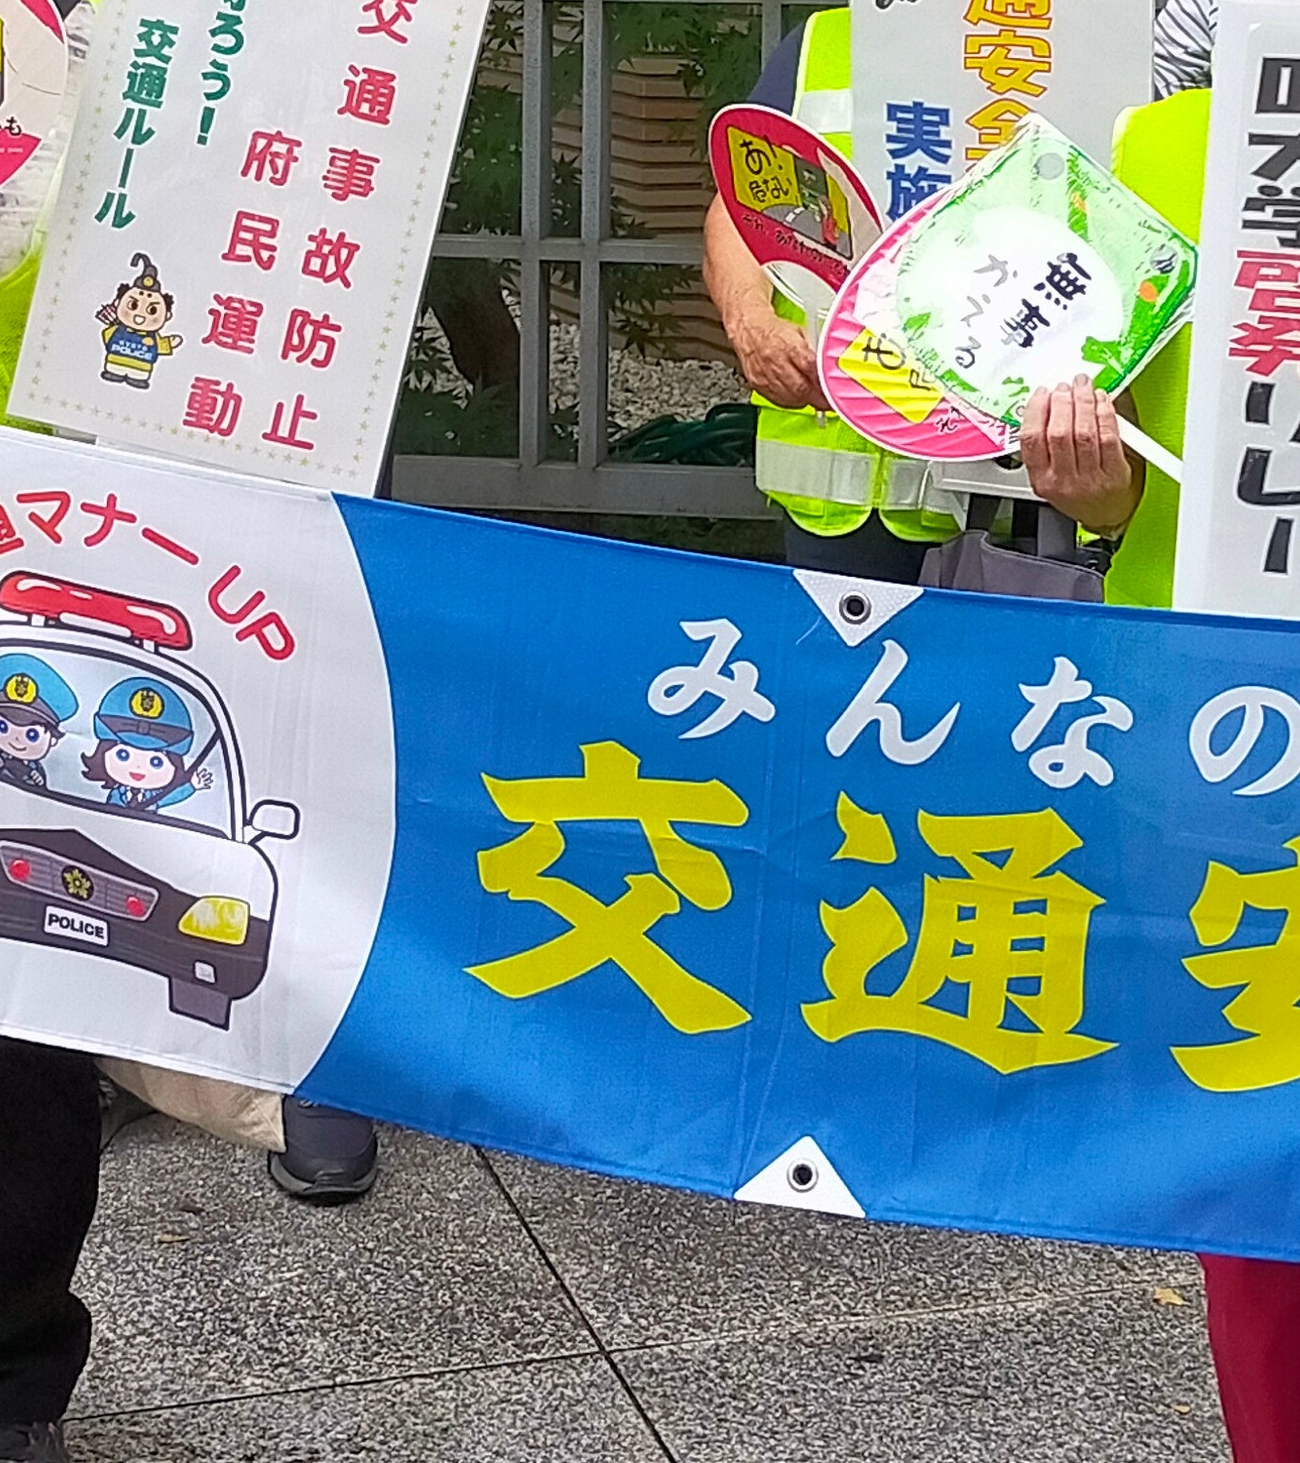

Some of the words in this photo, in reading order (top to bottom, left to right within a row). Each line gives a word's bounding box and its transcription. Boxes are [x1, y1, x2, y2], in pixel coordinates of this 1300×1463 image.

[94, 17, 180, 230] 交通ルール
[183, 129, 302, 438] 府民運動
[48, 913, 105, 939] POLICE
